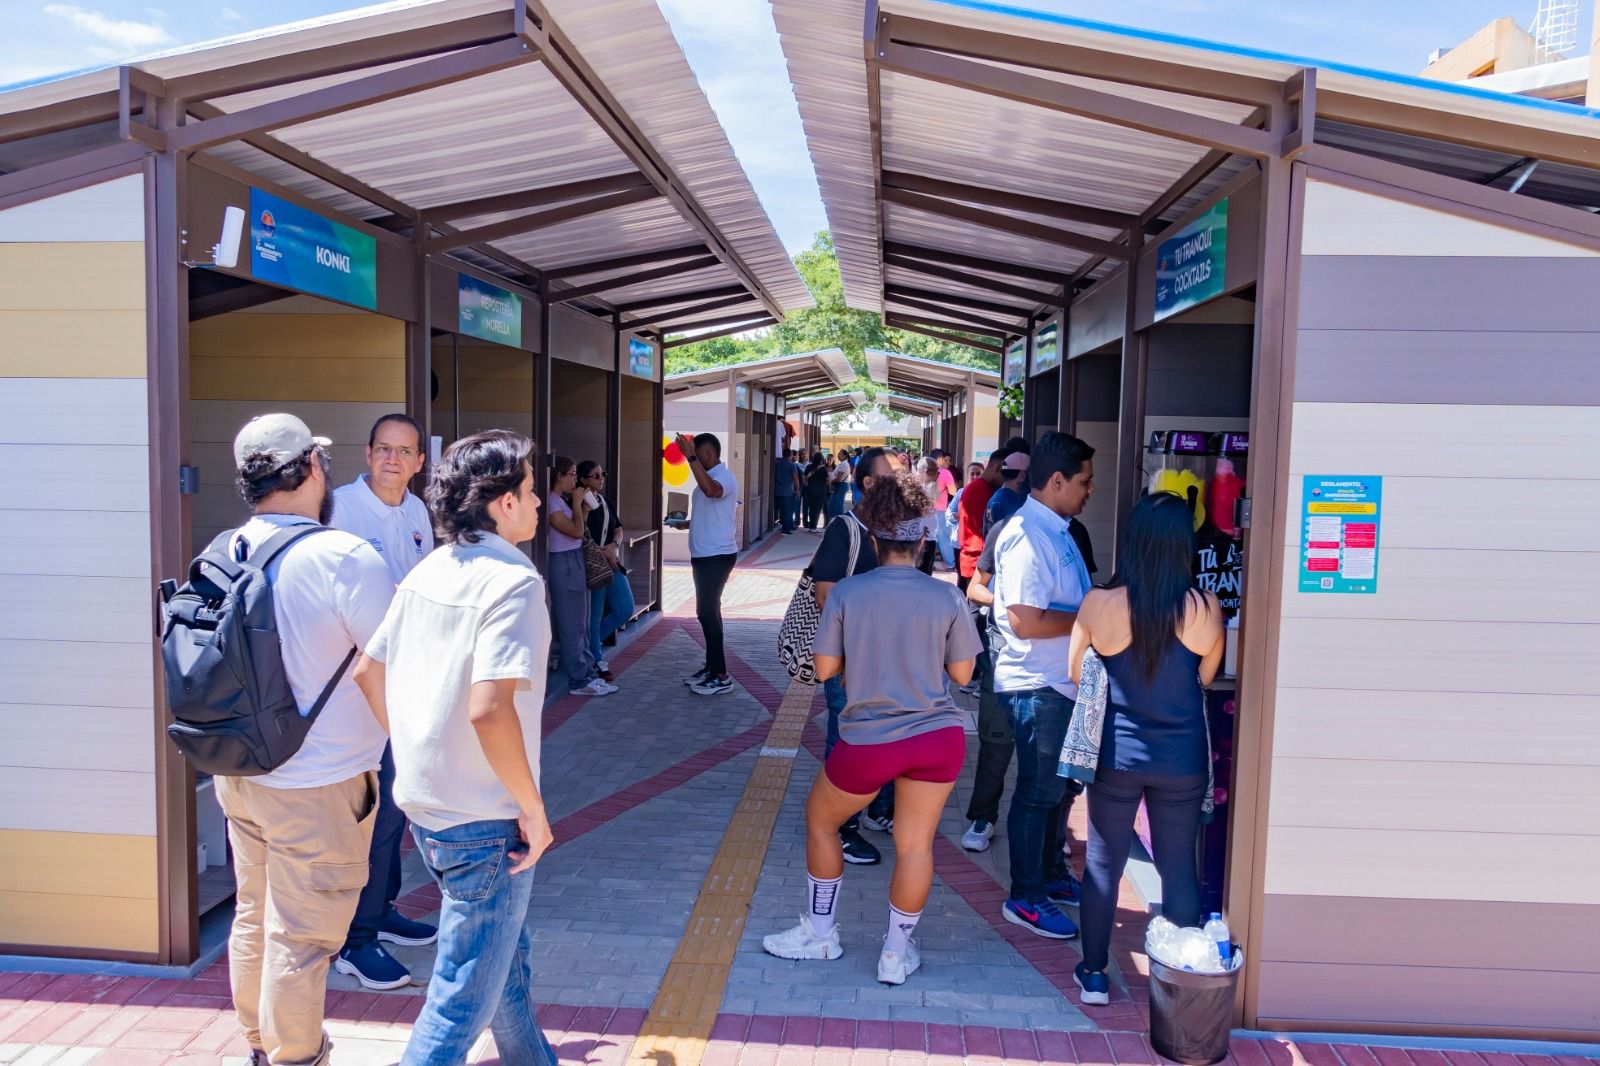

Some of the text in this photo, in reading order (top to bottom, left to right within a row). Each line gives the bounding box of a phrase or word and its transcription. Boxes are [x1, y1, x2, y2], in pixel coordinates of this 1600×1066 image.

[316, 245, 351, 274] KONKI
[1183, 227, 1213, 261] TRANQUI
[1174, 259, 1210, 294] COCKTAILS
